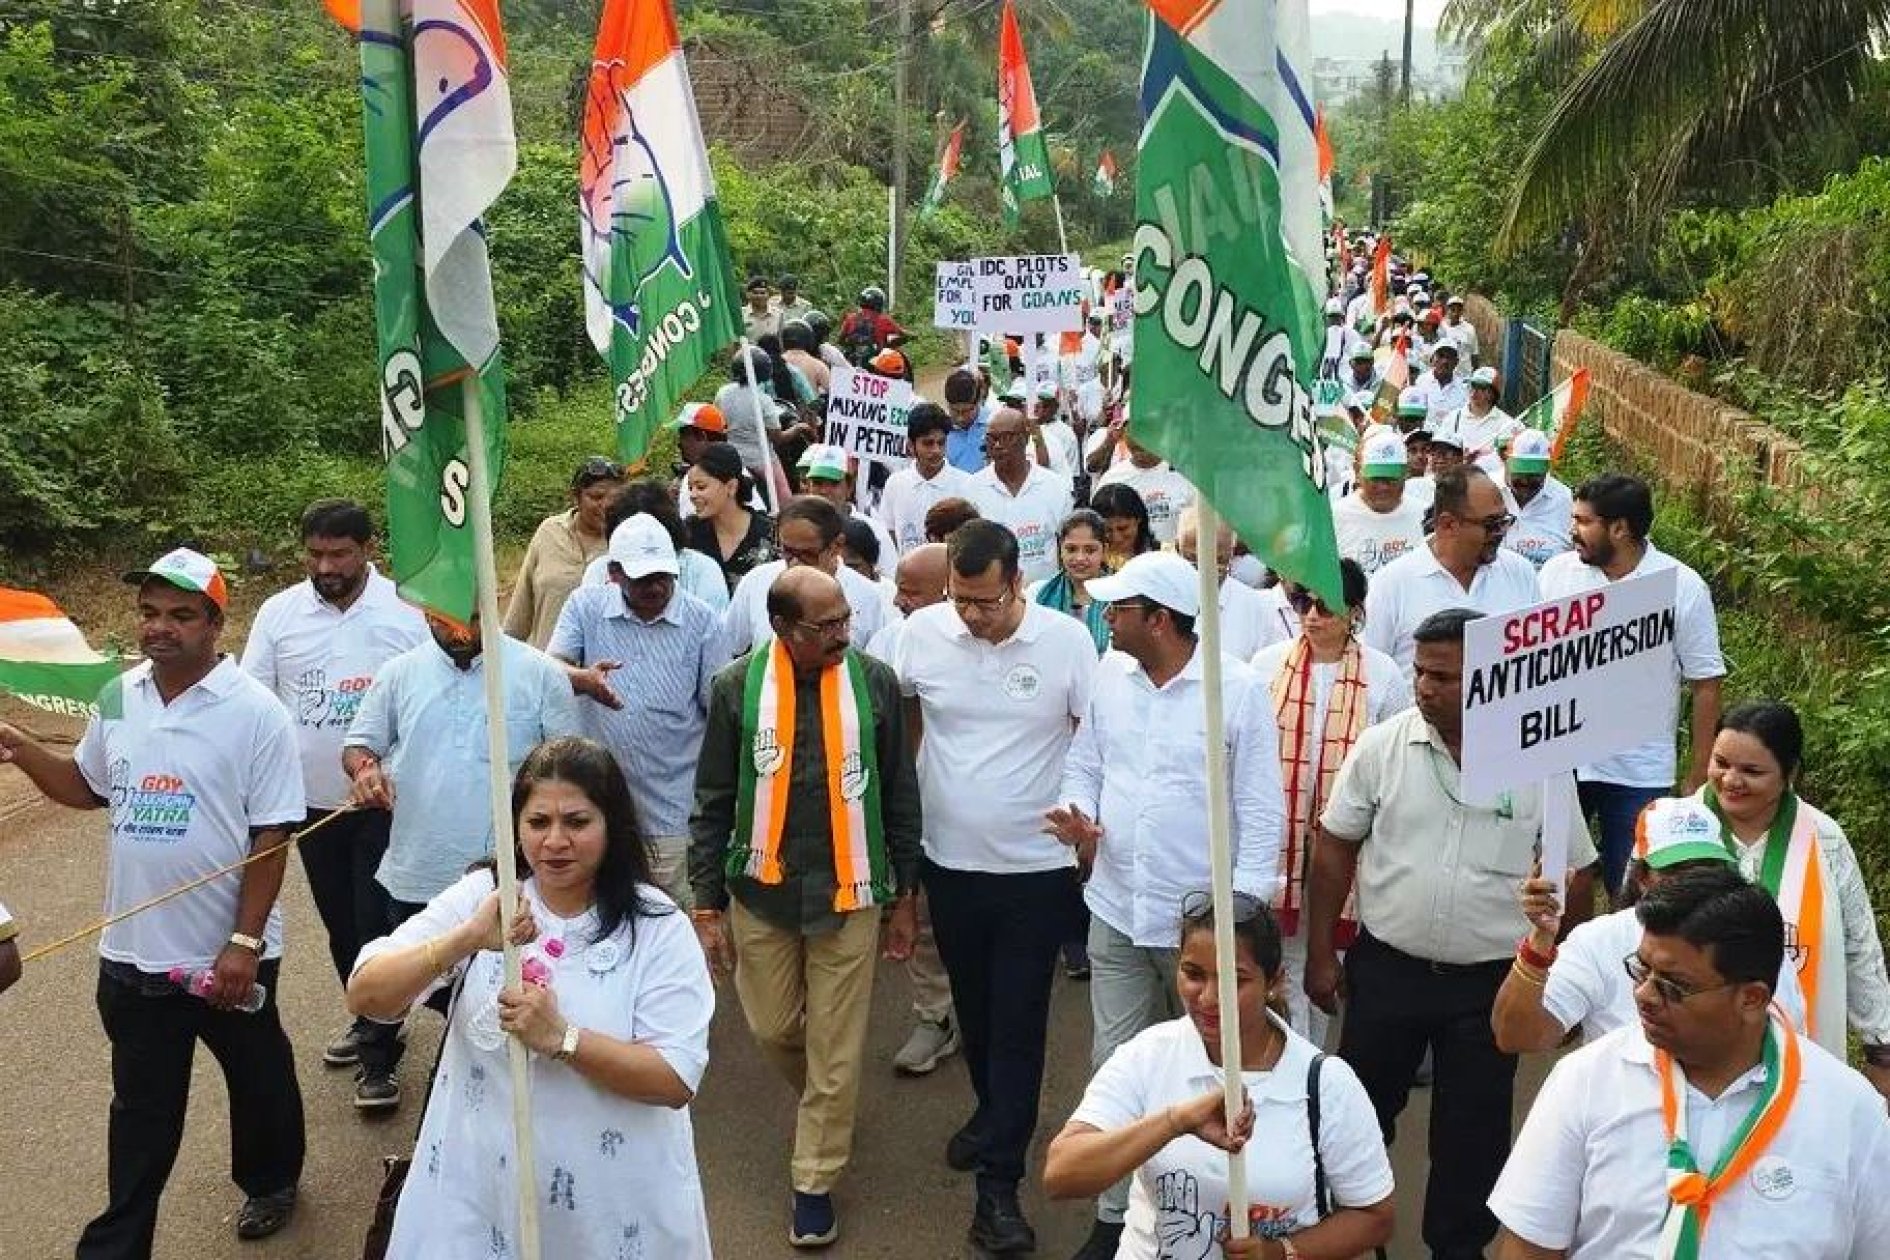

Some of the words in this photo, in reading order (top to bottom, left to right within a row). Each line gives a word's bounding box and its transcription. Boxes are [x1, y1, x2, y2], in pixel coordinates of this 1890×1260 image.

[979, 258, 1006, 276] IDC
[1017, 257, 1068, 273] PLOTS
[1004, 274, 1046, 290] ONLY
[938, 290, 962, 303] FOR
[983, 294, 1012, 311] FOR
[1021, 290, 1081, 309] GOANS
[852, 375, 889, 398] STOP
[831, 397, 887, 423] MIXING
[829, 422, 848, 447] IN
[855, 427, 913, 458] PETROL
[1503, 592, 1605, 655] SCRAP
[1466, 607, 1676, 710] ANTICONVERSION
[1520, 698, 1583, 750] BILL
[140, 774, 184, 793] GOY
[133, 807, 190, 823] YATRA
